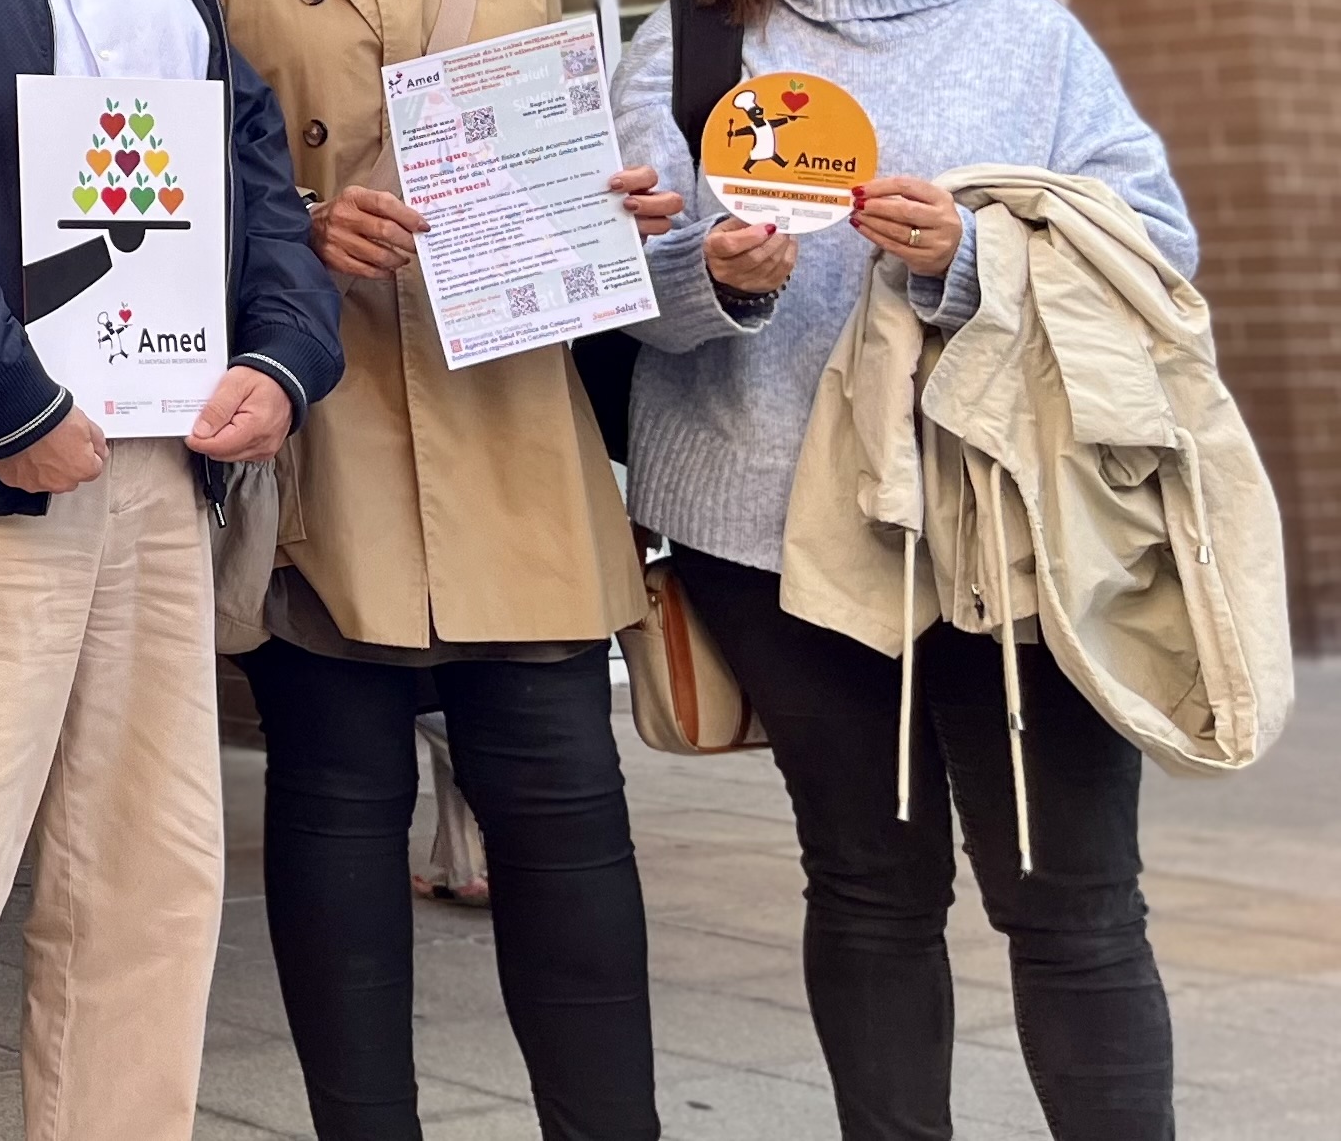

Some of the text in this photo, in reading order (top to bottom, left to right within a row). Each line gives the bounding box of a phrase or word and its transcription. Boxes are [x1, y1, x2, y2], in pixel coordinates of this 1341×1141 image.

[407, 71, 440, 89] Amed
[794, 152, 856, 174] Amed
[138, 327, 206, 353] Amed
